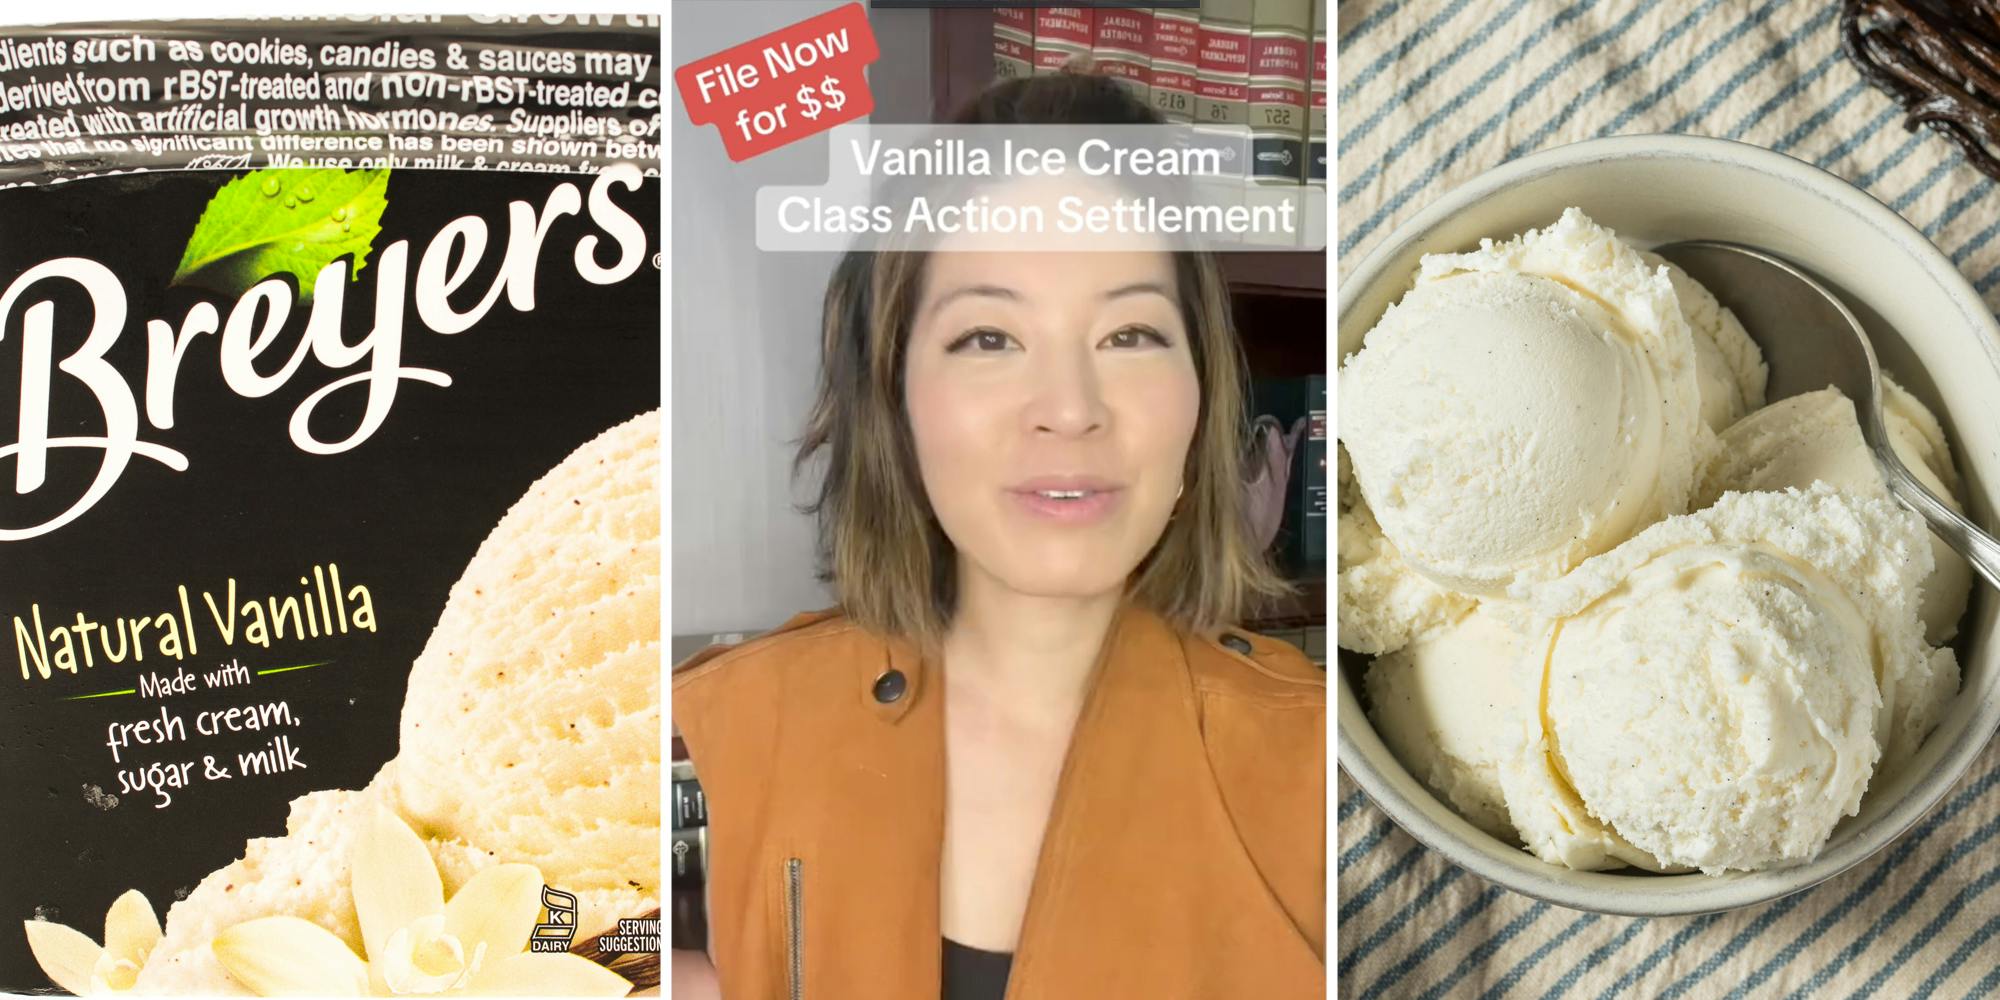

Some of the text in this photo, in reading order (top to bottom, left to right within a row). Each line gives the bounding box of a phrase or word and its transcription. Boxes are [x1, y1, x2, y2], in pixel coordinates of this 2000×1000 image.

[72, 35, 155, 63] such
[168, 40, 203, 61] as
[210, 38, 313, 69] cookies,
[320, 42, 436, 69] candies
[446, 44, 469, 70] &
[479, 49, 576, 74] sauces
[584, 52, 652, 82] may
[77, 71, 149, 104] from
[164, 69, 320, 102] rBST-treated
[326, 73, 371, 100] and
[382, 73, 629, 107] non-rBST-treated
[82, 106, 135, 135] with
[140, 103, 247, 132] artificial
[254, 104, 341, 136] growth
[343, 104, 496, 132] hormones.
[506, 108, 622, 138] Suppliers
[629, 113, 660, 136] of
[40, 137, 86, 156] that
[94, 140, 128, 151] no
[131, 135, 251, 156] significant
[261, 135, 383, 151] difference
[388, 134, 433, 151] has
[441, 135, 504, 152] been
[512, 137, 597, 157] shown
[267, 153, 302, 168] We
[415, 154, 464, 169] milk
[0, 163, 646, 541] Breyers
[13, 562, 377, 680] Natural Vanilla
[139, 658, 251, 699] Made with
[106, 701, 301, 763] fresh cream,
[118, 735, 307, 809] sugar & milk
[532, 940, 570, 952] DAIRY
